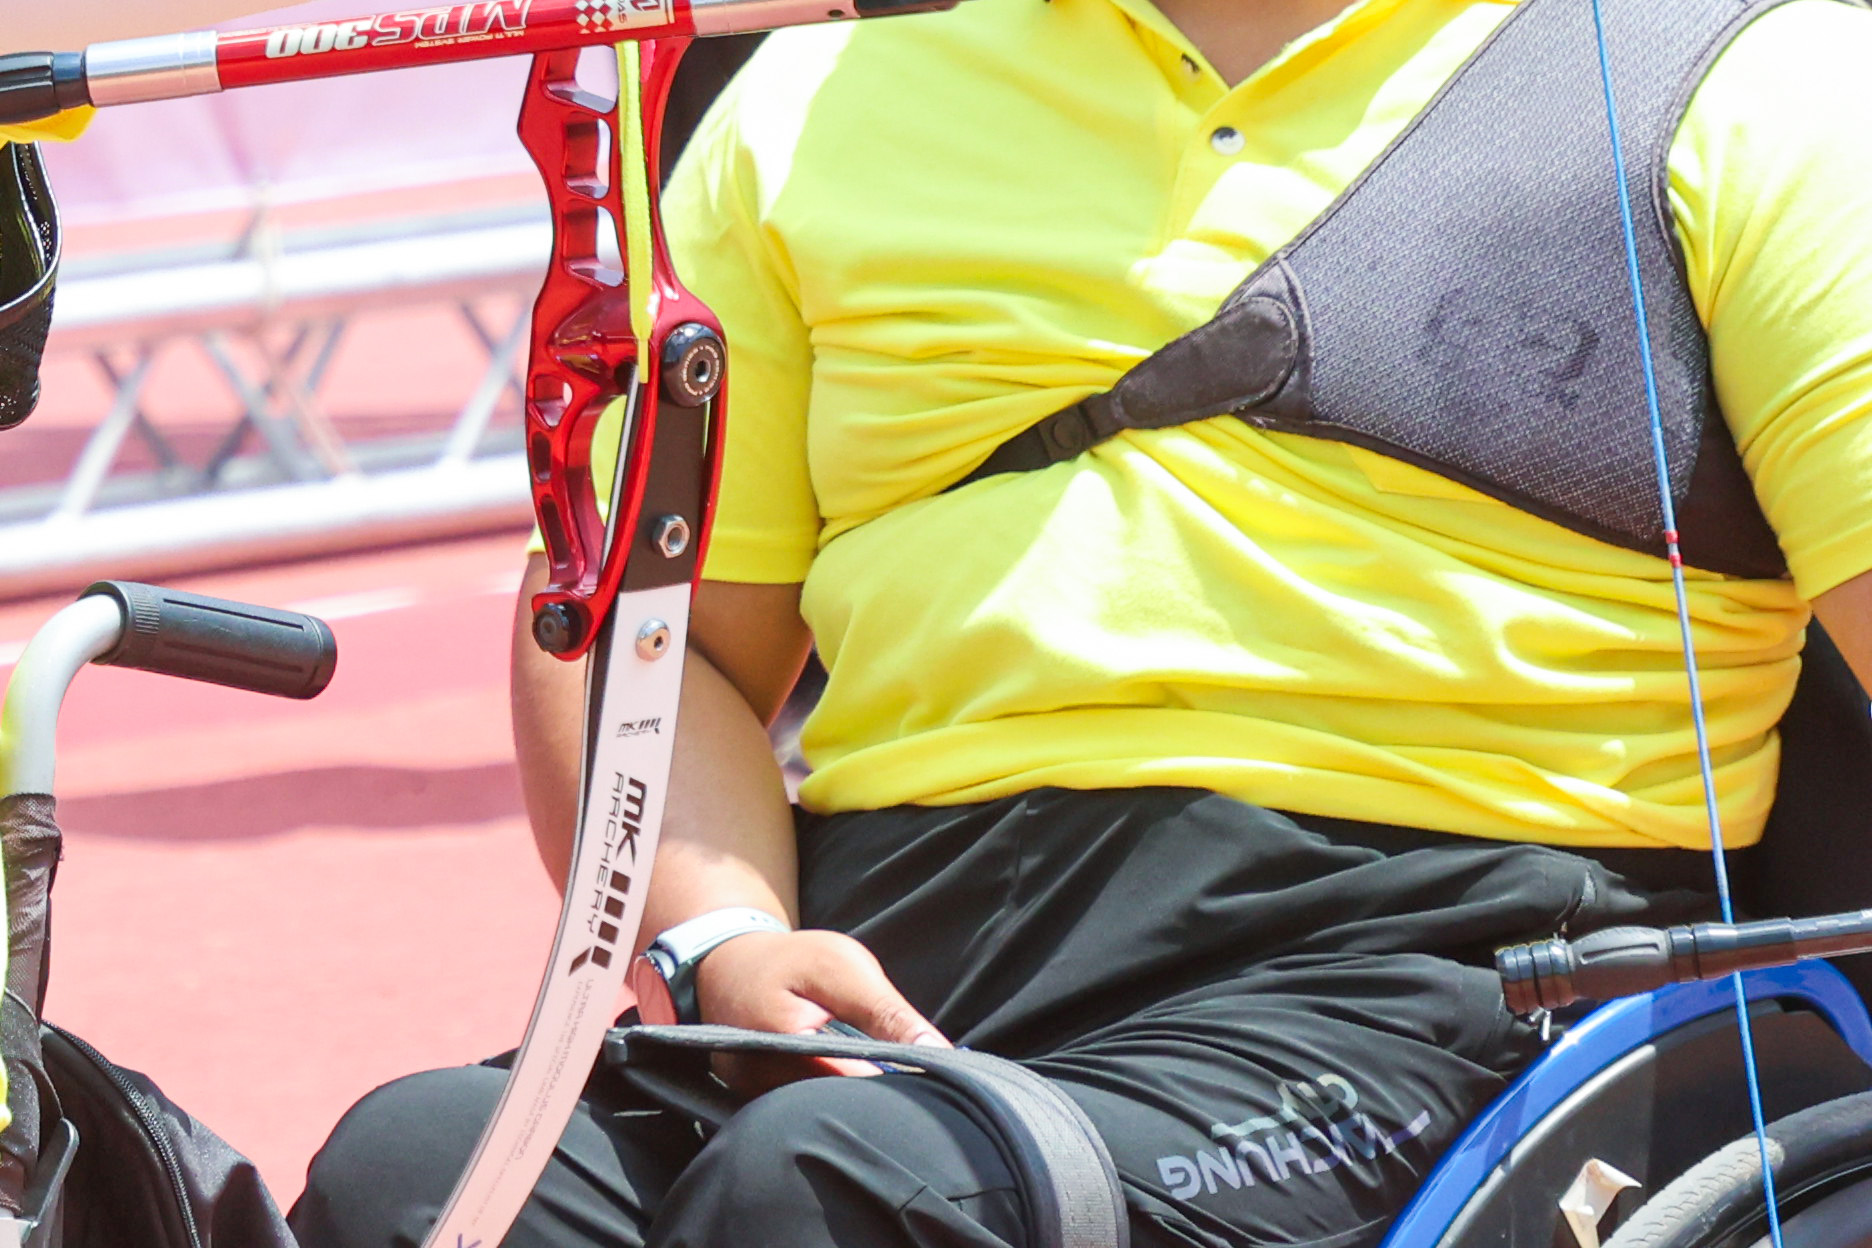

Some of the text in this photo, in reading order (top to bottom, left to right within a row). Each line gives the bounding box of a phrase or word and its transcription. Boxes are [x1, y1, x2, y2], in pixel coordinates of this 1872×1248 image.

[264, 21, 376, 59] 300
[586, 771, 625, 938] ARCHERY
[615, 778, 648, 868] MK
